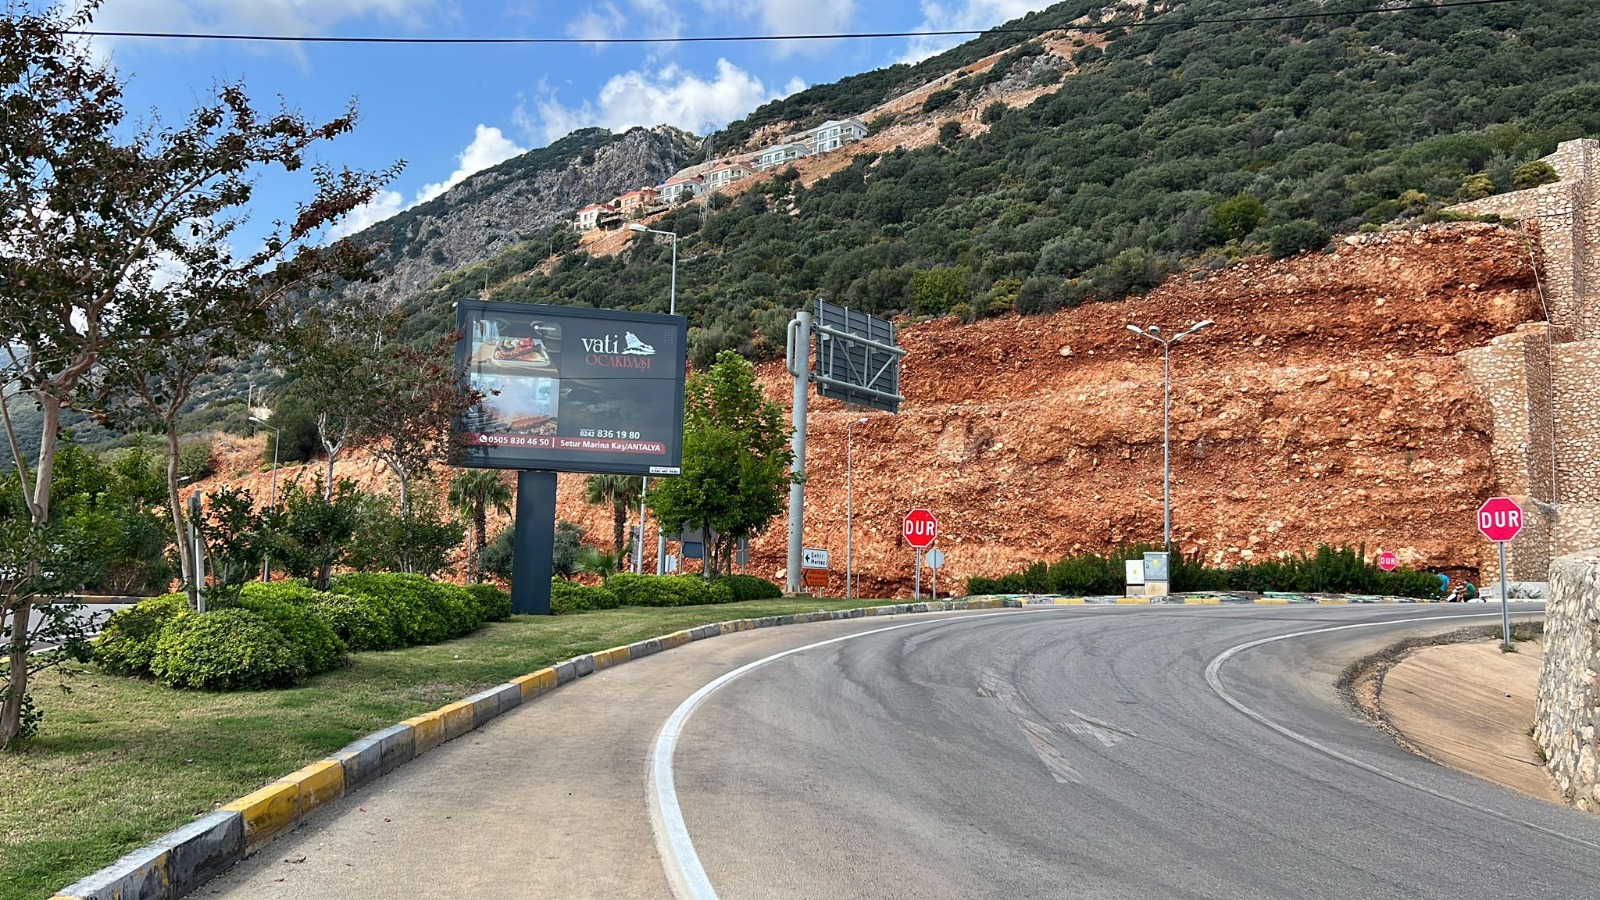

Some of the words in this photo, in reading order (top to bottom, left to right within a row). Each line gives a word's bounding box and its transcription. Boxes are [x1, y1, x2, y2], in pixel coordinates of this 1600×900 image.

[581, 334, 619, 354] vati
[585, 354, 651, 372] OCAKBAŞI
[488, 436, 508, 444] 0505
[510, 437, 525, 445] 830
[527, 437, 537, 445] 46
[539, 438, 549, 446] 50
[580, 430, 595, 438] 0242
[597, 429, 614, 438] 836
[616, 430, 627, 439] 19
[629, 431, 641, 440] 80
[560, 440, 581, 448] Setur
[582, 441, 610, 449] Marina
[611, 442, 661, 452] Kaş/ANTALYA
[1481, 510, 1519, 529] DUR
[905, 519, 935, 536] DUR
[1380, 556, 1396, 565] DUR
